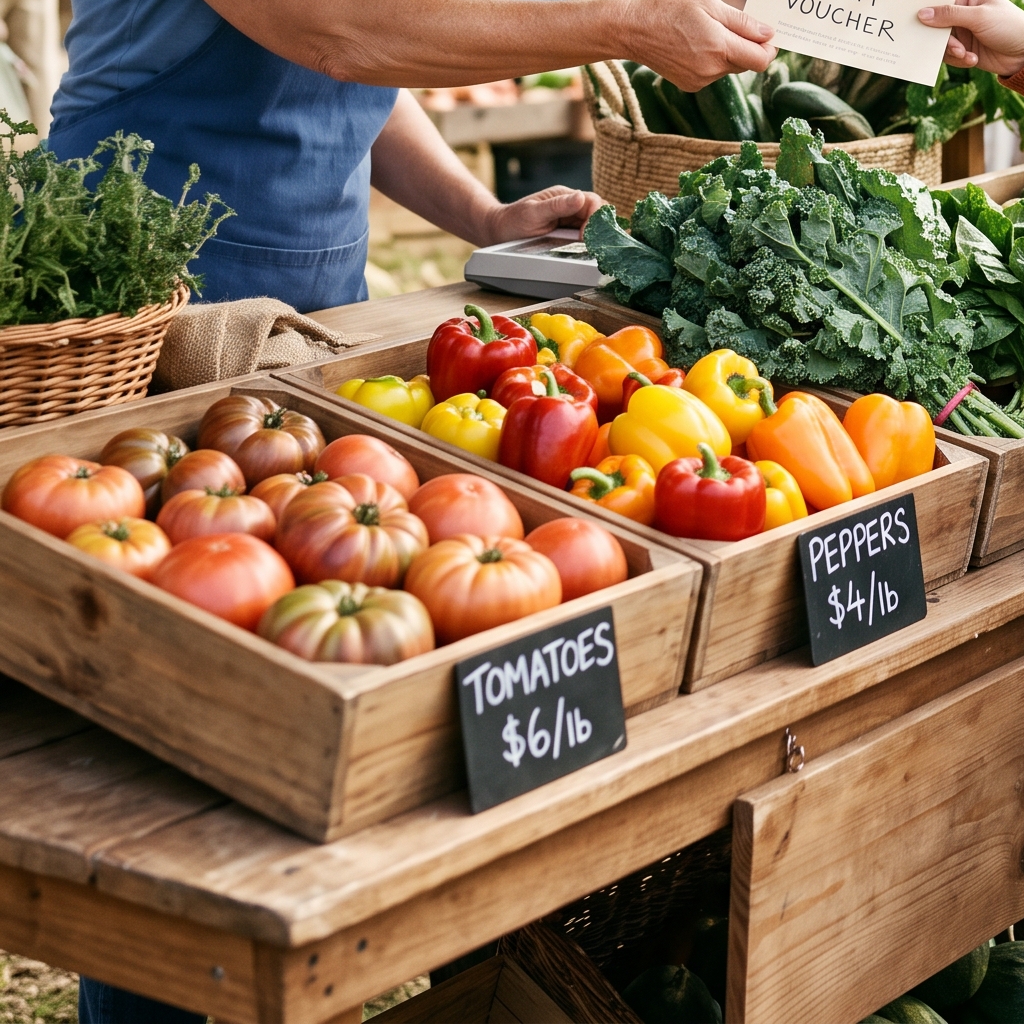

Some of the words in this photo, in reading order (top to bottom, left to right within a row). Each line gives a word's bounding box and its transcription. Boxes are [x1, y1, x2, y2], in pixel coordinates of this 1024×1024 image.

[808, 507, 910, 582] PEPPERS
[827, 570, 899, 630] $4/lb
[462, 621, 614, 715] TOMATOES
[502, 696, 593, 768] $6/lb
